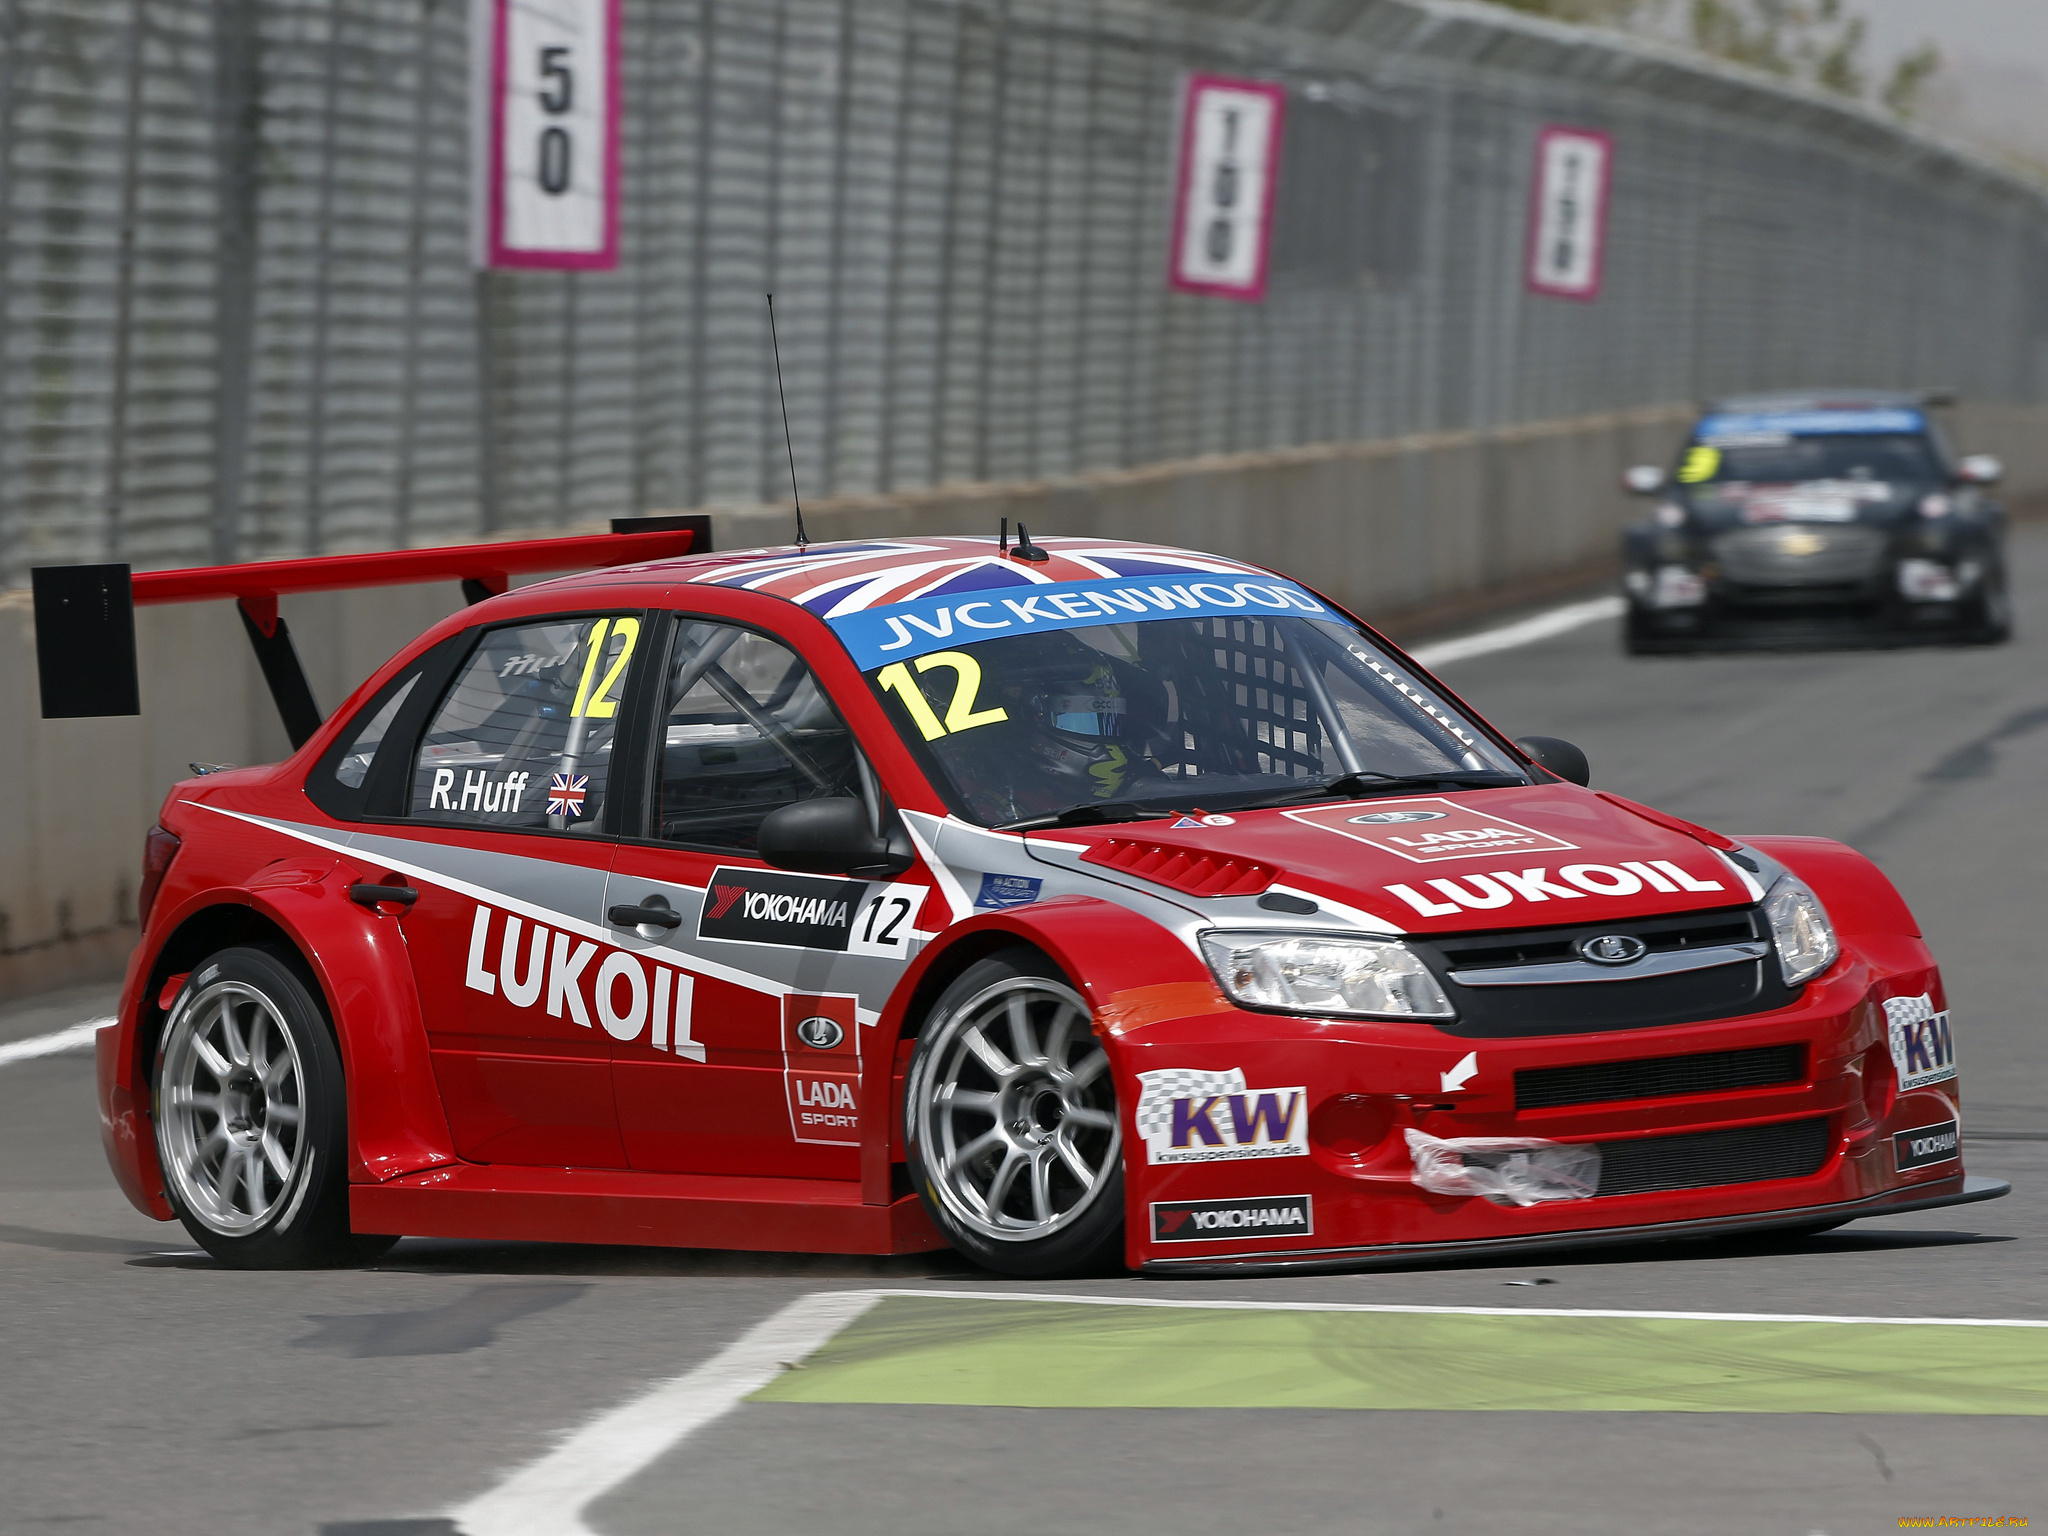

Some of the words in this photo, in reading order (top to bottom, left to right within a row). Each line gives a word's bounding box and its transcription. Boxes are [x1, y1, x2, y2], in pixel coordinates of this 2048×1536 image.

[538, 46, 572, 196] 50
[1207, 110, 1239, 263] 100
[570, 617, 640, 719] 12
[876, 650, 1010, 743] 12
[429, 768, 530, 813] R.Huff
[1387, 827, 1526, 847] LADA
[1417, 837, 1536, 853] SPORT
[1382, 859, 1726, 918] LUKOIL
[743, 891, 848, 928] YOKOHAMA
[862, 895, 911, 946] 12
[465, 904, 707, 1064] LUKOIL
[1903, 1015, 1954, 1076] KW
[796, 1079, 857, 1110] LADA
[801, 1112, 858, 1128] SPORT
[1171, 1091, 1305, 1150] KW
[1155, 1143, 1303, 1164] kwsuspensions.de
[1910, 1131, 1958, 1158] YOKOHAMA
[1191, 1206, 1306, 1230] YOKOHAMA
